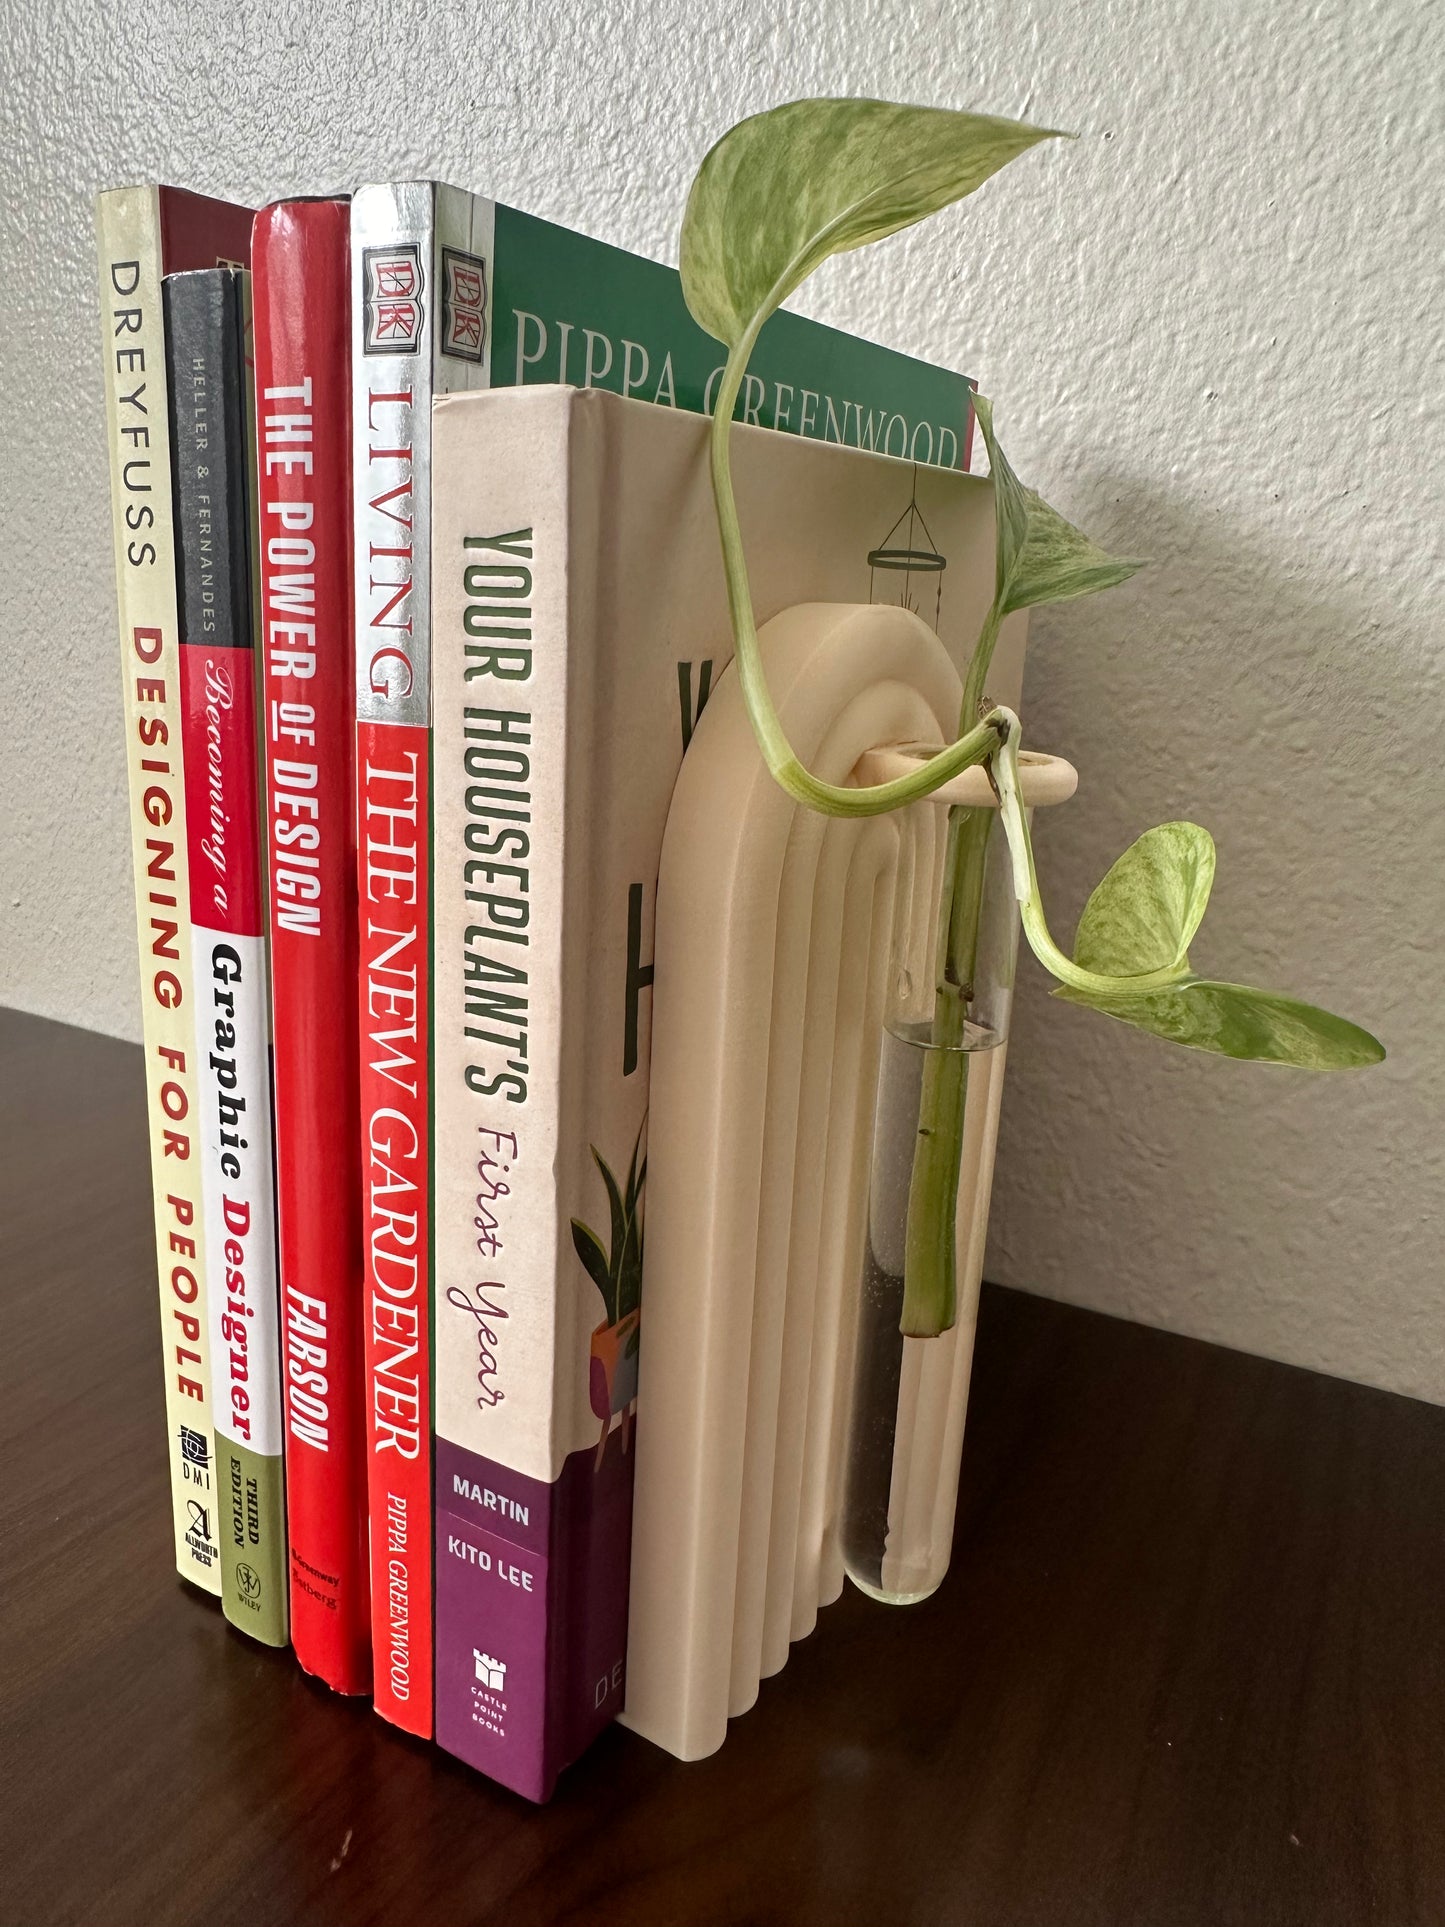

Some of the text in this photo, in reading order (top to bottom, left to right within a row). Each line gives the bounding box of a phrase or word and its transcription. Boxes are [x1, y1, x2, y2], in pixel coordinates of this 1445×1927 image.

[111, 261, 156, 567] DREYFUSS
[512, 309, 677, 409] PIPPA
[192, 357, 215, 633] HELLER & FERNANDES
[368, 385, 413, 699] LIVING
[264, 377, 321, 937] THE POWER OF DESIGN
[201, 659, 234, 921] Becoming a
[463, 527, 533, 1104] YOUR HOUSEPLANT'S
[133, 627, 204, 1404] DESIGNING FOR PEOPLE
[365, 752, 420, 1460] THE NEW GARDENER
[209, 944, 254, 1441] Graphic Designer
[446, 1127, 518, 1410] First Year
[286, 1285, 329, 1452] FARSON
[183, 1462, 210, 1490] DMI
[191, 1549, 212, 1567] PRESS
[230, 1456, 244, 1549] EDITION
[246, 1478, 260, 1545] THIRD
[453, 1474, 529, 1526] MARTIN
[238, 1592, 261, 1612] WILEY
[387, 1492, 410, 1701] PIPPA GREENWOOD
[448, 1535, 533, 1592] KITO LEE
[471, 1686, 507, 1711] CASTLE
[472, 1713, 505, 1736] BOOKS
[474, 1701, 503, 1722] POINT
